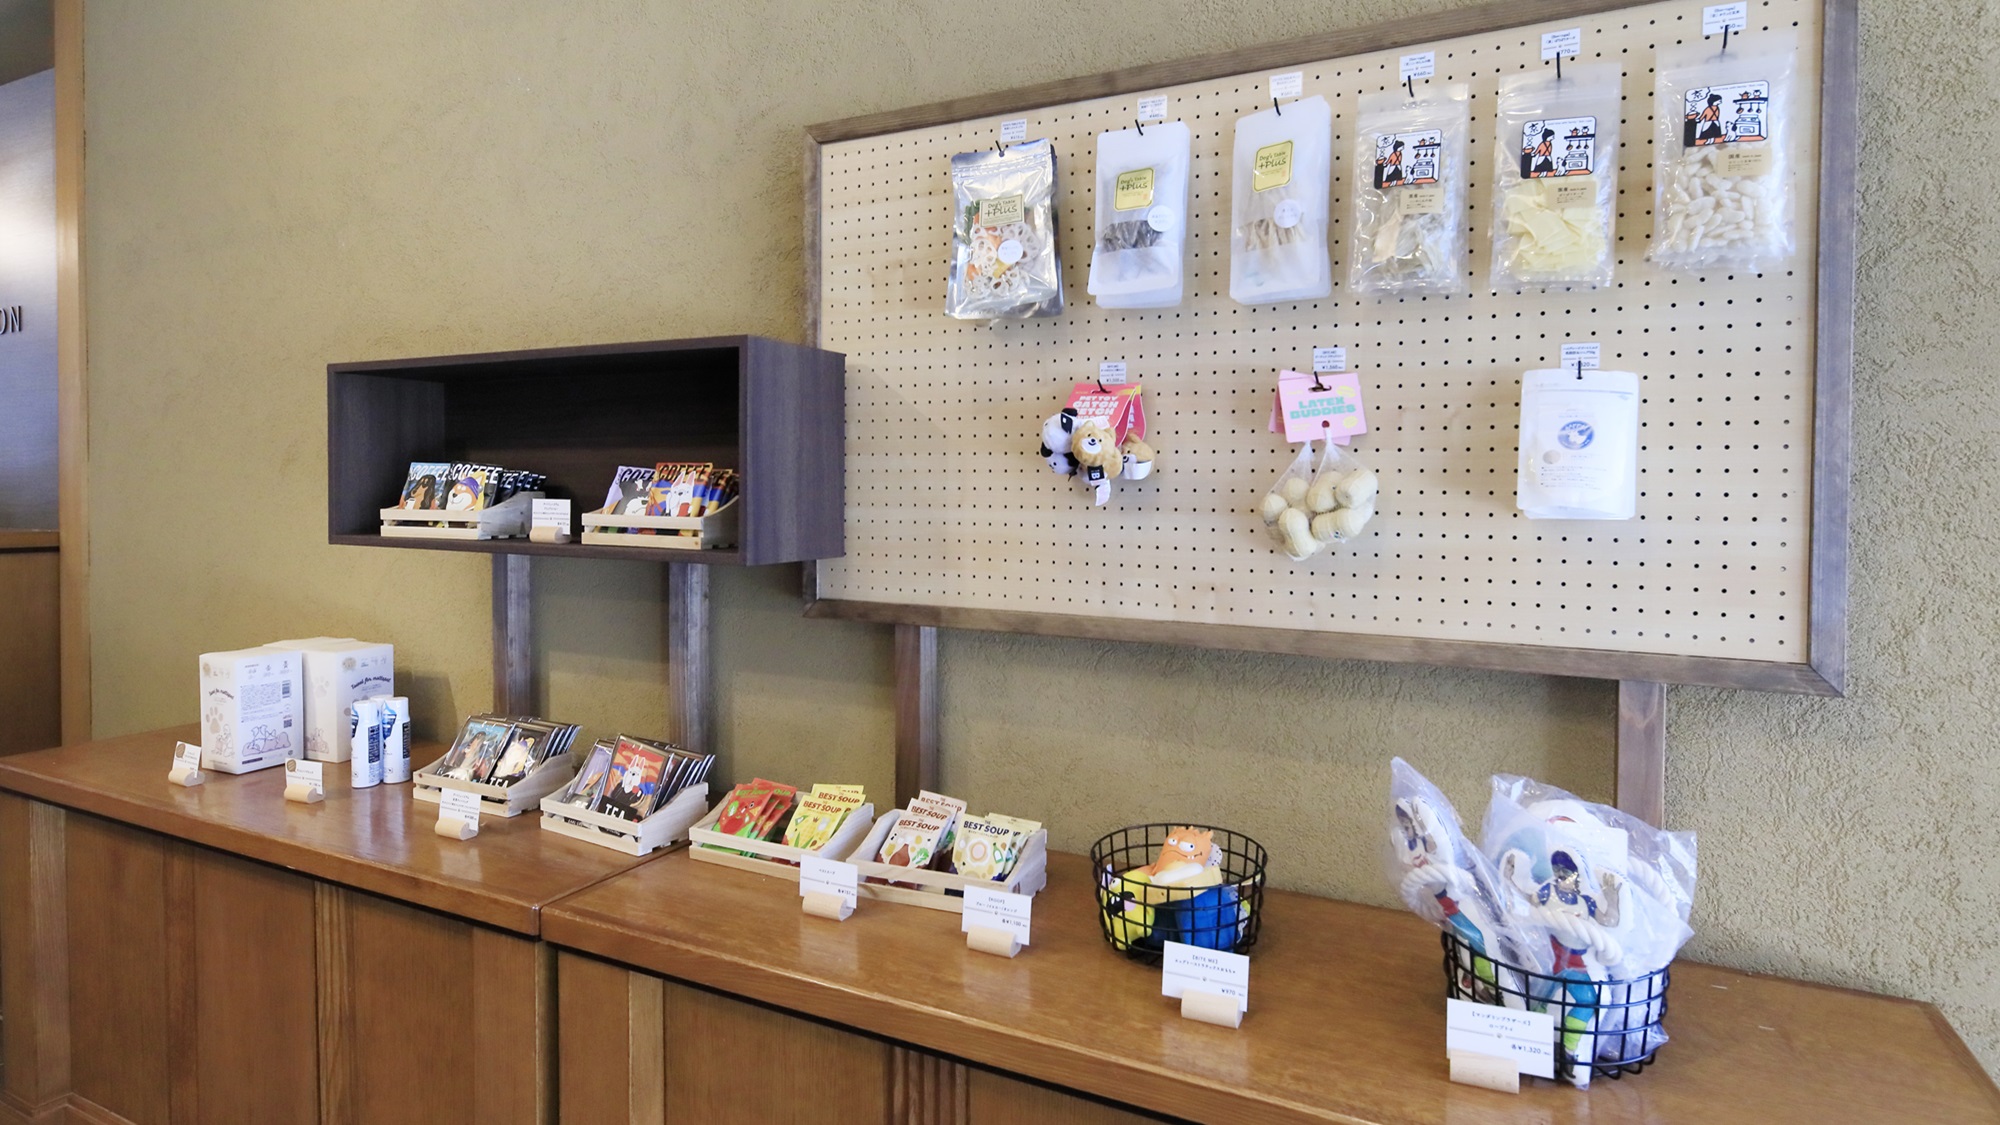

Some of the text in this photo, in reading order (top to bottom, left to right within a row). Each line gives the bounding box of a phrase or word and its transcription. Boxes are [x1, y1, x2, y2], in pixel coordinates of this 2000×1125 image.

[1298, 397, 1345, 409] LATEX
[1077, 408, 1115, 416] ETCH
[1289, 404, 1357, 420] BUDDIES
[451, 463, 504, 485] COFFEE
[659, 464, 710, 484] COFFEE
[817, 792, 860, 805] BEST SOUP
[803, 801, 843, 814] BEST SOUP
[910, 805, 928, 816] BEST
[926, 811, 948, 821] SOUP
[898, 819, 918, 829] BEST
[917, 823, 940, 832] SOUP
[963, 820, 985, 832] BEST
[984, 825, 1010, 837] SOUP
